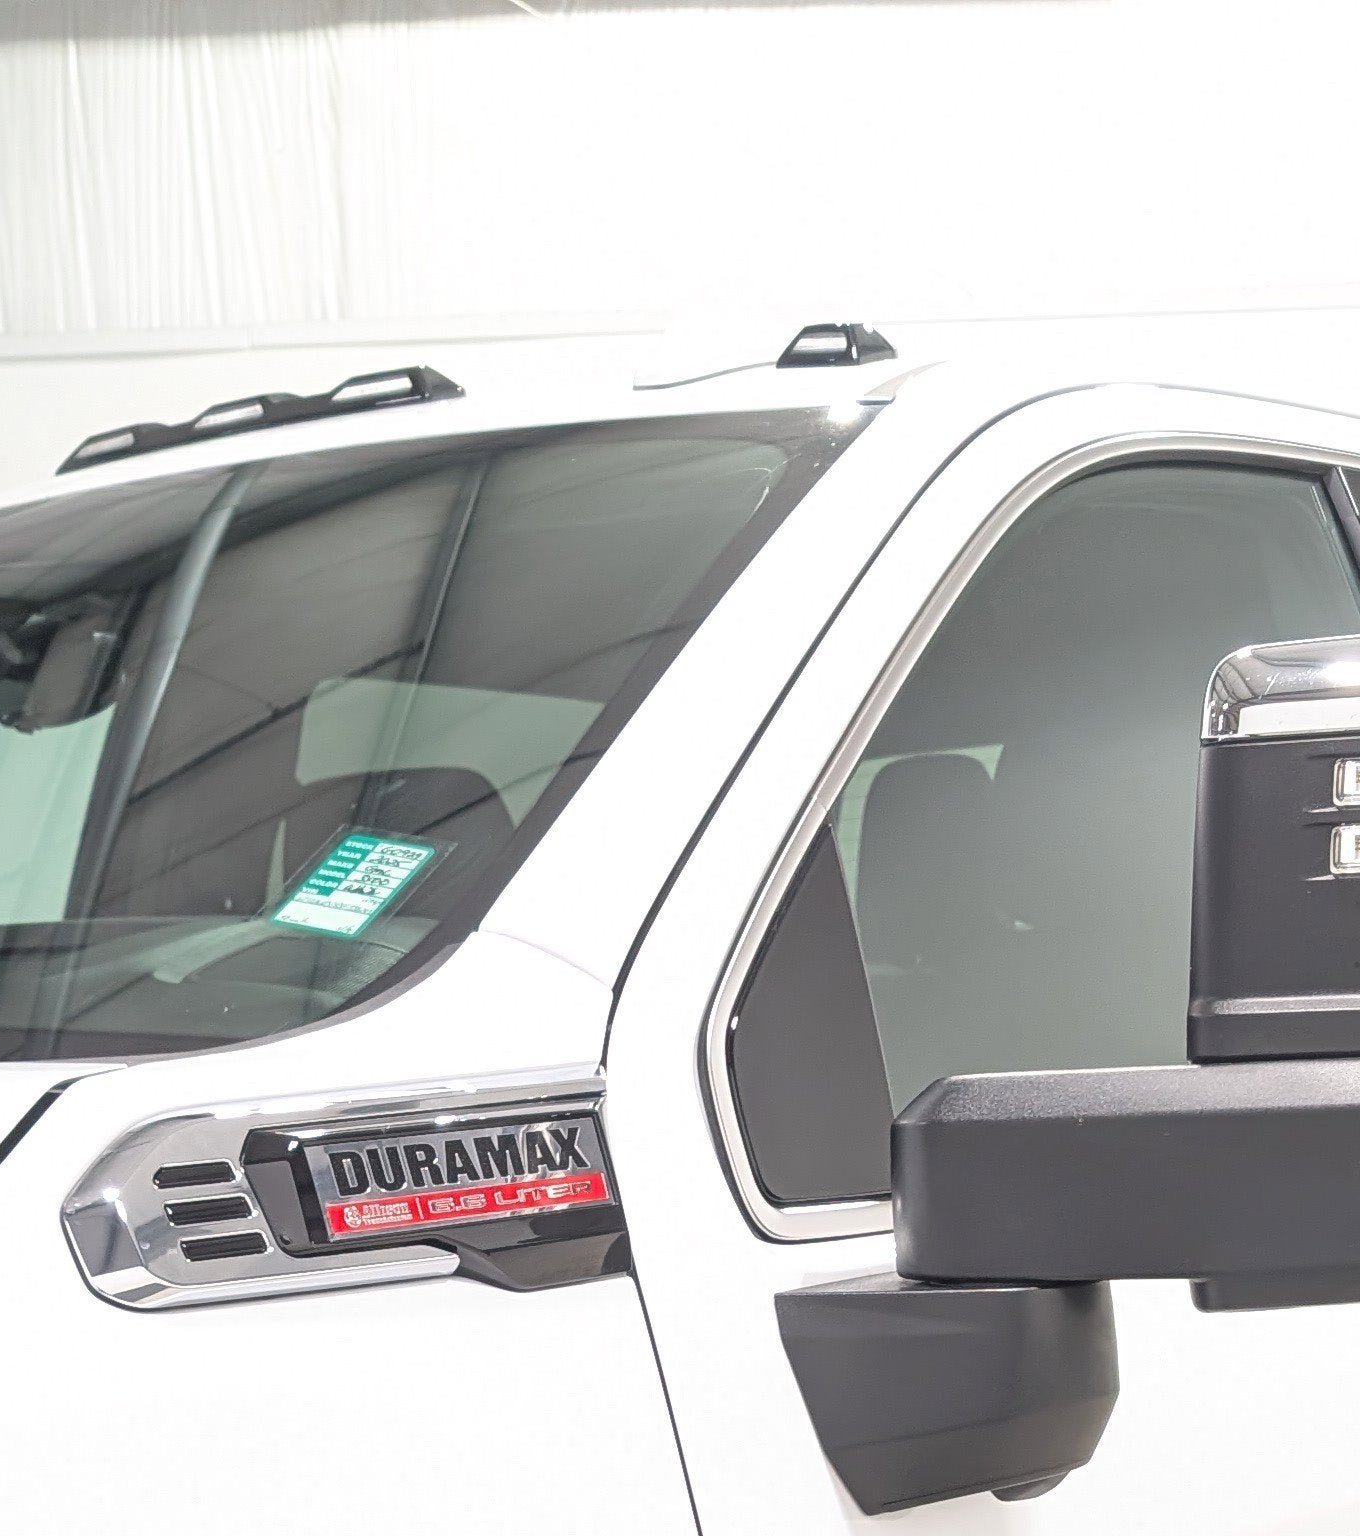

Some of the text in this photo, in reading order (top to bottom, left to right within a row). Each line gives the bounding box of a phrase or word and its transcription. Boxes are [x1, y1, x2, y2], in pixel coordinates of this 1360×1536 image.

[337, 850, 362, 860] YEAR
[308, 879, 339, 889] COLOR
[330, 1126, 591, 1197] DURAMAX
[428, 1180, 592, 1214] 6.6 LITER
